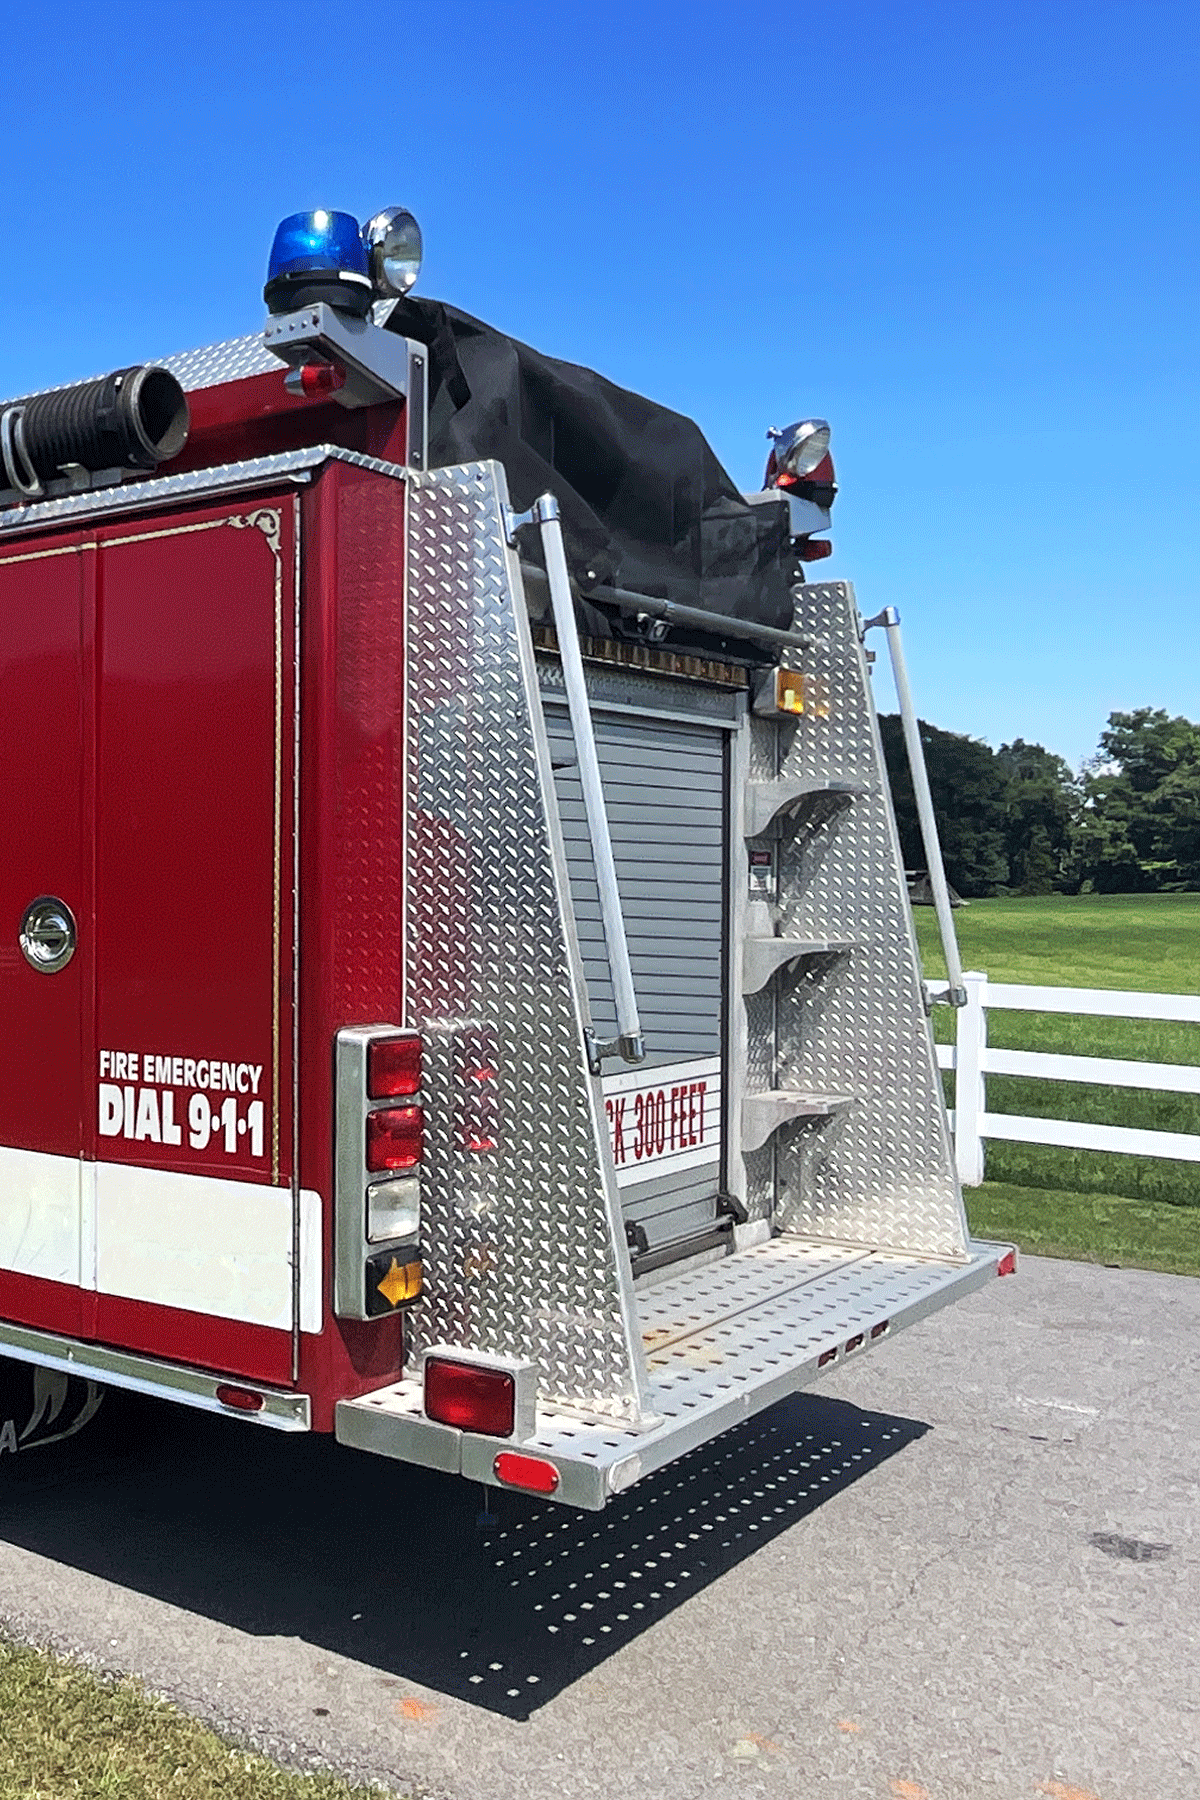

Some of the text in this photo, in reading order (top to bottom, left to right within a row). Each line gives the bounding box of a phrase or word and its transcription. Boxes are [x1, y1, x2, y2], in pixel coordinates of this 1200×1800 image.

[100, 1050, 263, 1094] FIRE EMERGENCY
[99, 1083, 182, 1146] DIAL
[634, 1089, 665, 1160] 300
[671, 1081, 707, 1151] FEET
